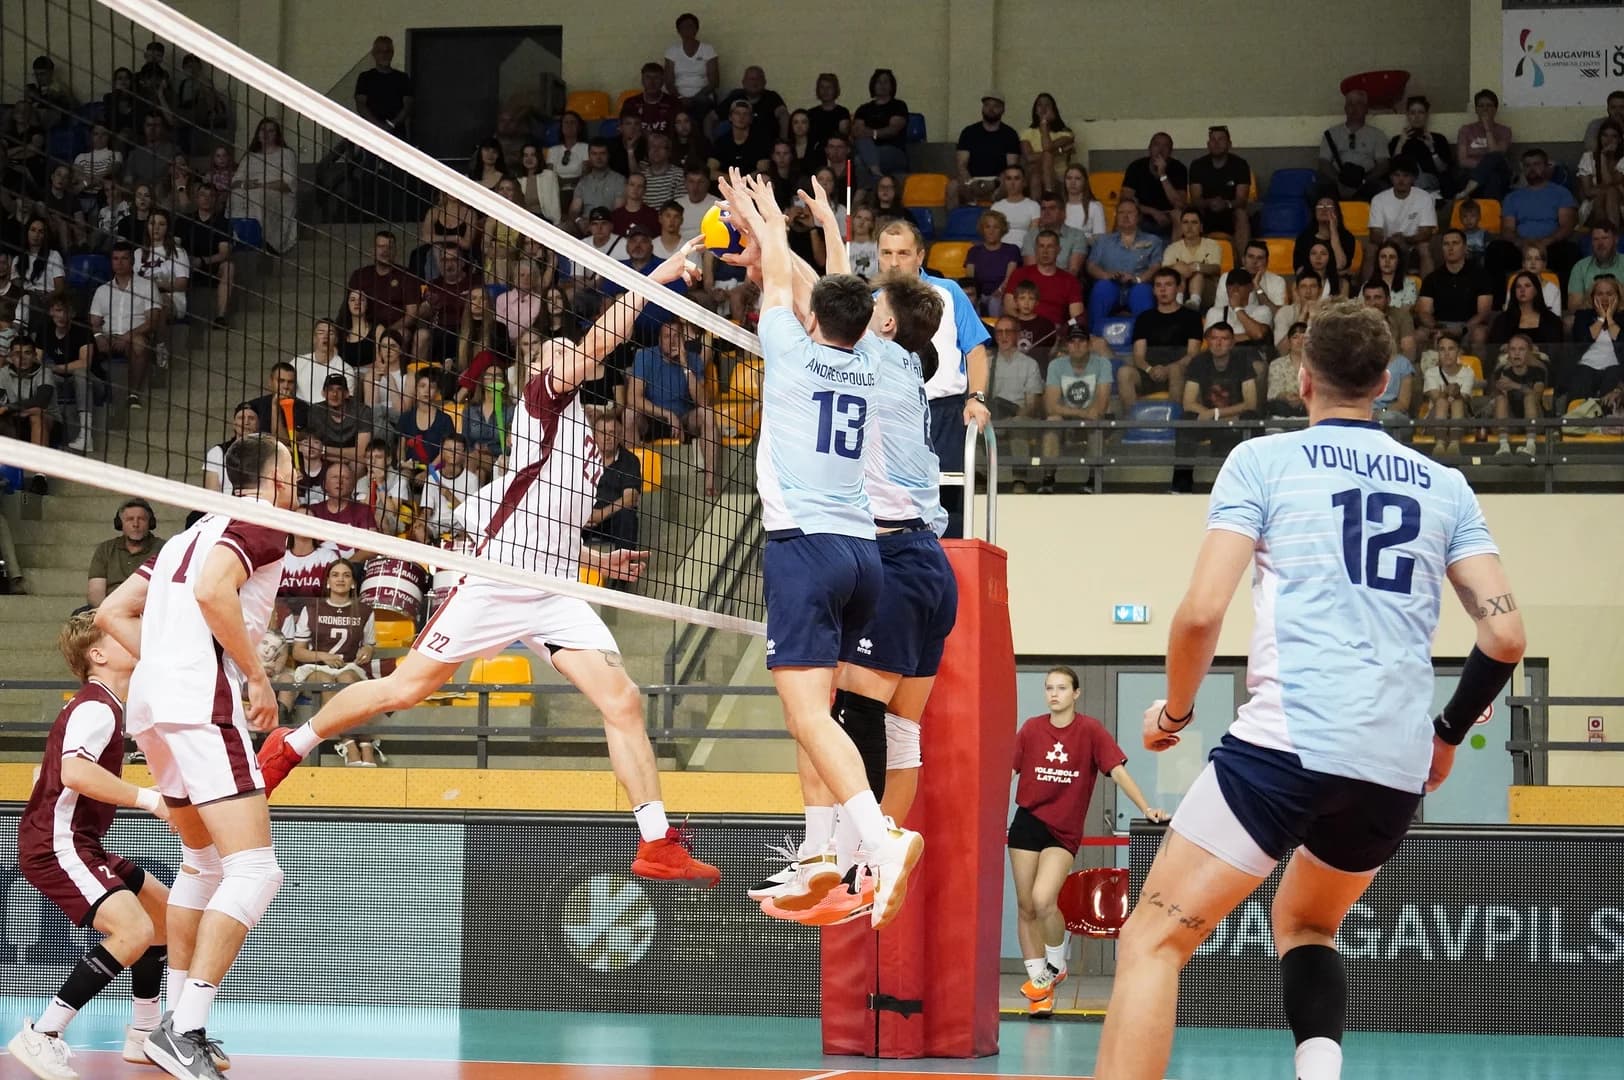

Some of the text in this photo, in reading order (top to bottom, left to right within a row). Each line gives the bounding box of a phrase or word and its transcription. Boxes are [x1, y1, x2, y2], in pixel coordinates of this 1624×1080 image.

[1543, 50, 1601, 59] DAUGAVPILS
[811, 391, 867, 460] 13
[1302, 444, 1431, 490] VOULKIDIS
[1331, 487, 1422, 595] 12
[279, 576, 321, 588] ATVIJA
[317, 615, 362, 627] KRONBERGS
[328, 628, 348, 659] 2
[426, 632, 451, 654] 22
[1036, 774, 1073, 784] LATVIJA
[97, 864, 116, 880] 2
